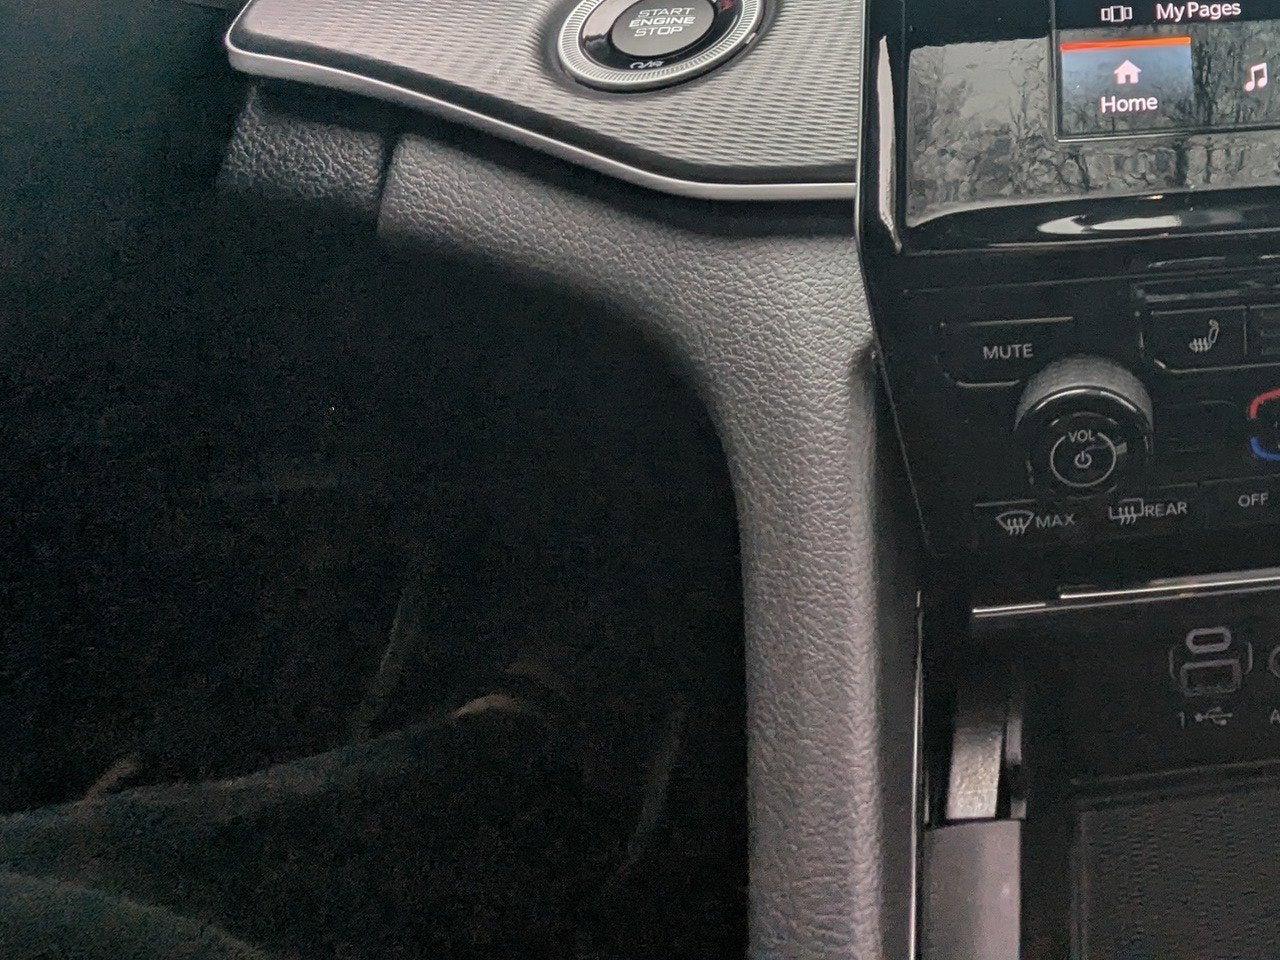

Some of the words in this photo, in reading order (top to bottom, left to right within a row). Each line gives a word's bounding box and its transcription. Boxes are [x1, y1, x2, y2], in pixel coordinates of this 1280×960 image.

[638, 7, 694, 16] START
[1155, 3, 1186, 22] My
[1188, 0, 1242, 20] Pages
[629, 16, 696, 27] ENGINE
[634, 27, 682, 36] STOP
[1100, 94, 1159, 114] Home
[982, 343, 1035, 360] MUTE
[1067, 429, 1094, 443] VOL
[1144, 500, 1188, 518] REAR
[1237, 493, 1270, 509] OFF
[1036, 513, 1076, 529] MAX
